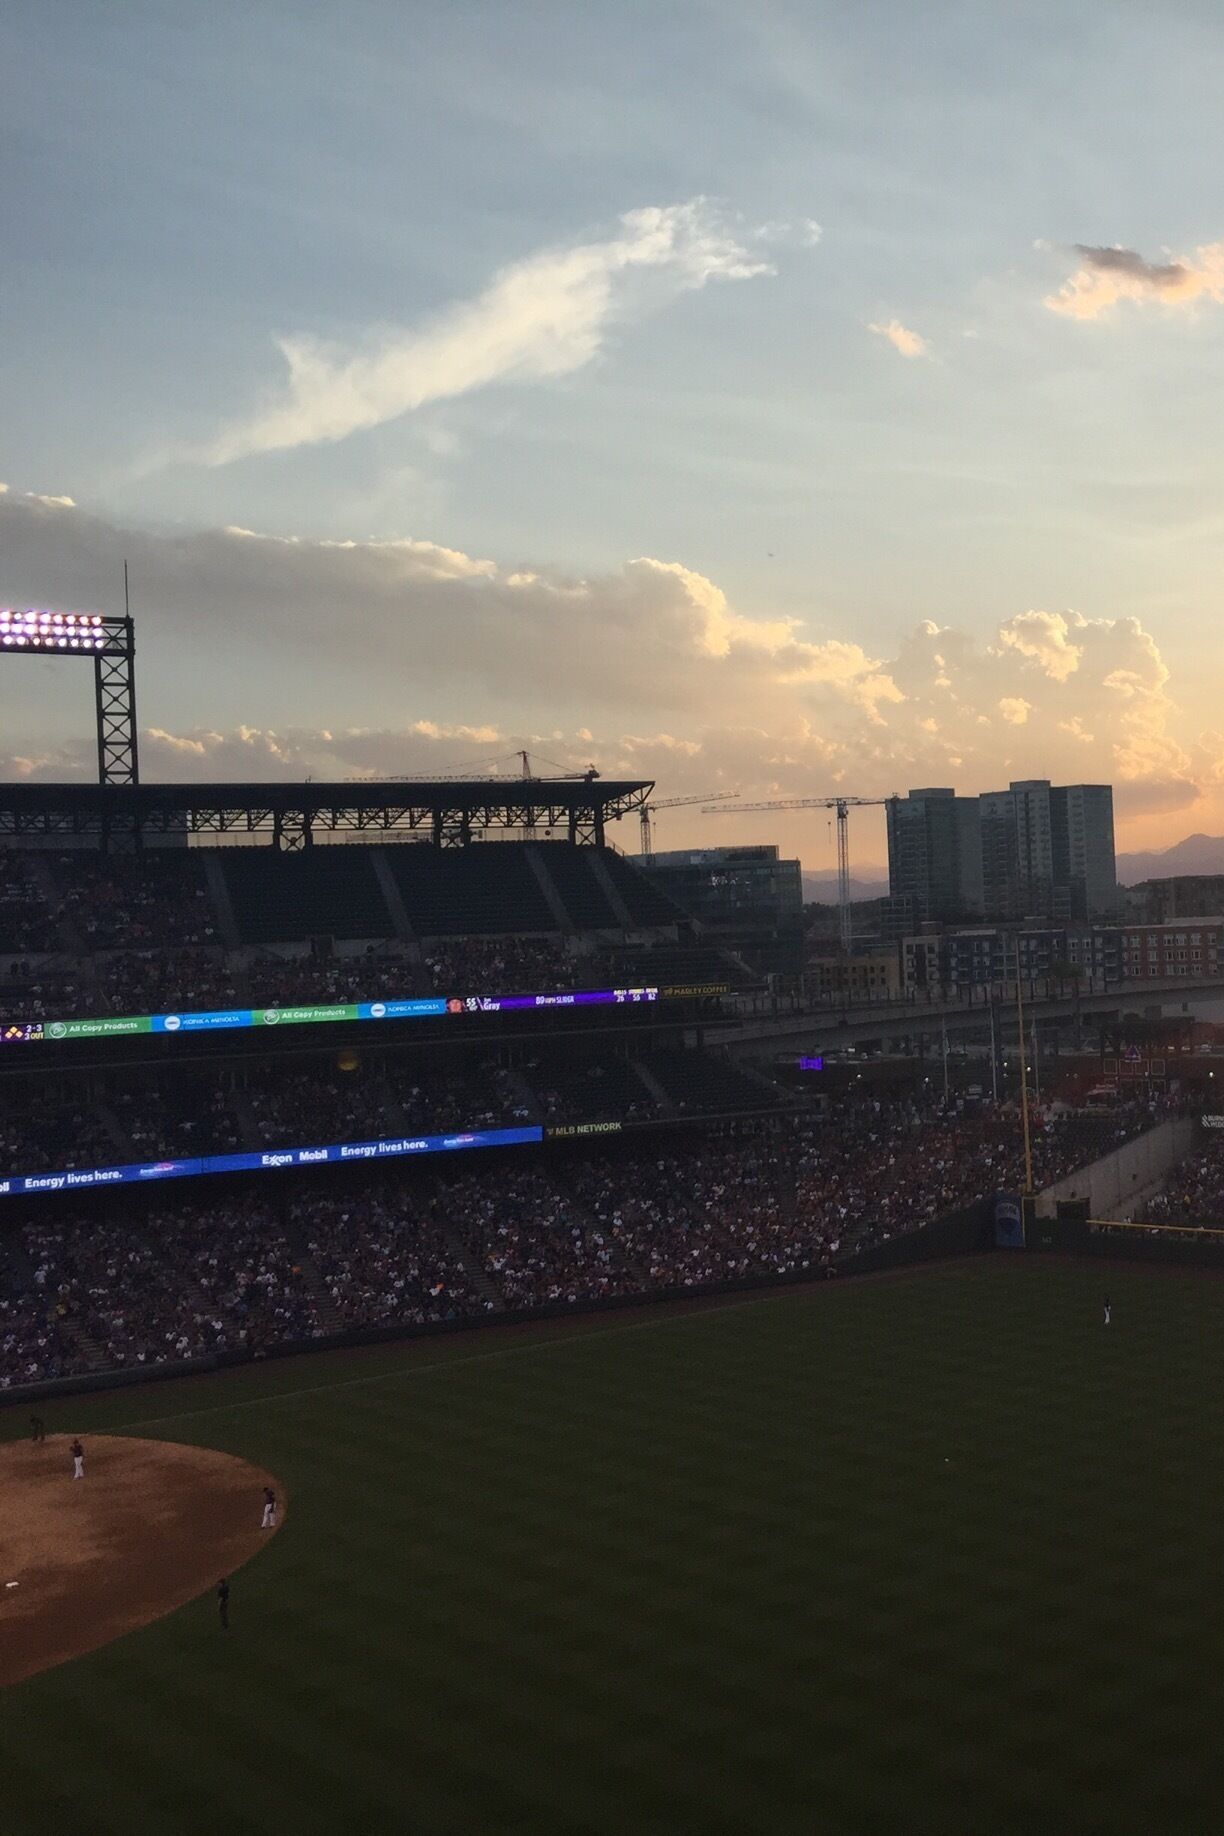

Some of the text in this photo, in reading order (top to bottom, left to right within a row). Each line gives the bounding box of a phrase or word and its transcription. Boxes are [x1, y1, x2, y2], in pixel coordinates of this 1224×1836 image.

[484, 1001, 501, 1011] Gray
[281, 1008, 346, 1020] All Copy Products
[26, 1023, 42, 1033] 2-3
[82, 1024, 103, 1035] Copy
[104, 1020, 138, 1031] Products
[24, 1031, 44, 1040] 3 OUT
[555, 1122, 622, 1136] MLB NETWORK
[262, 1140, 429, 1166] Exxon Mobil Energy lives here.
[25, 1177, 65, 1190] Energy
[67, 1173, 93, 1184] lives
[94, 1170, 123, 1182] here.
